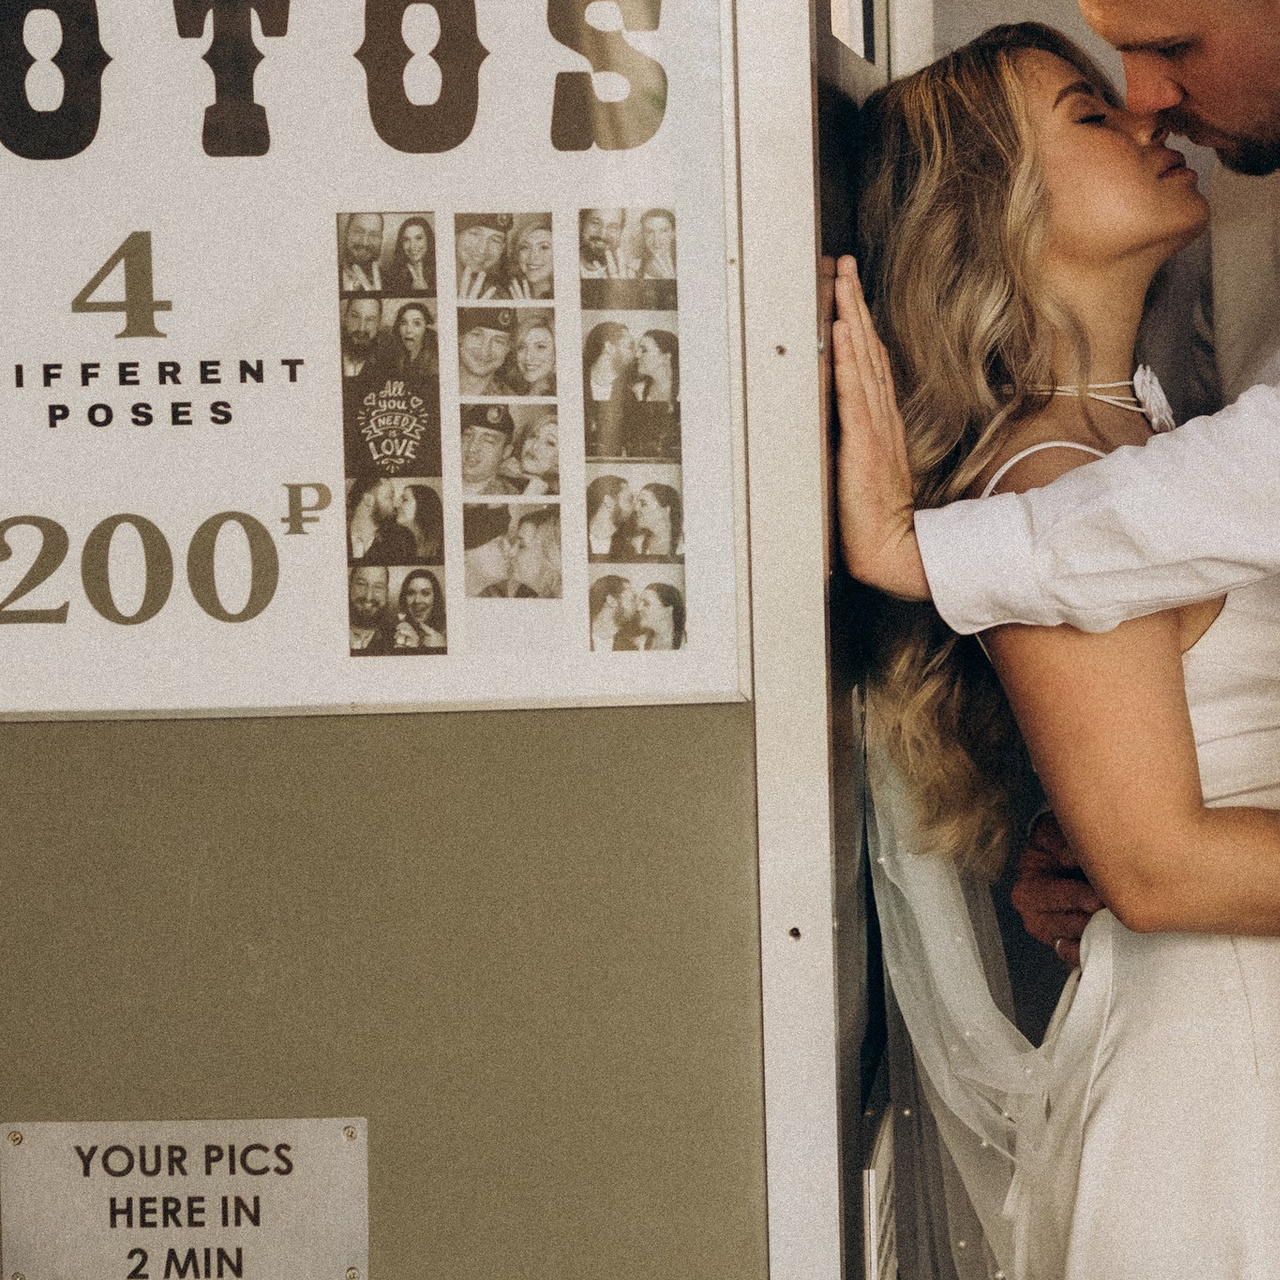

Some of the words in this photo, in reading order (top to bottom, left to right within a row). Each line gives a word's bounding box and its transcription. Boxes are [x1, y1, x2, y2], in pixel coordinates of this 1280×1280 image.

[71, 231, 173, 339] 4
[15, 358, 304, 388] IFFERENT
[379, 380, 405, 397] All
[48, 400, 233, 428] POSES
[371, 399, 408, 417] you
[377, 415, 410, 428] NEED
[368, 438, 419, 460] LOVE
[75, 1144, 188, 1178] YOUR
[204, 1143, 294, 1177] PICS
[109, 1196, 206, 1229] HERE
[221, 1195, 261, 1228] IN
[126, 1247, 149, 1280] 2
[163, 1247, 244, 1280] MIN
